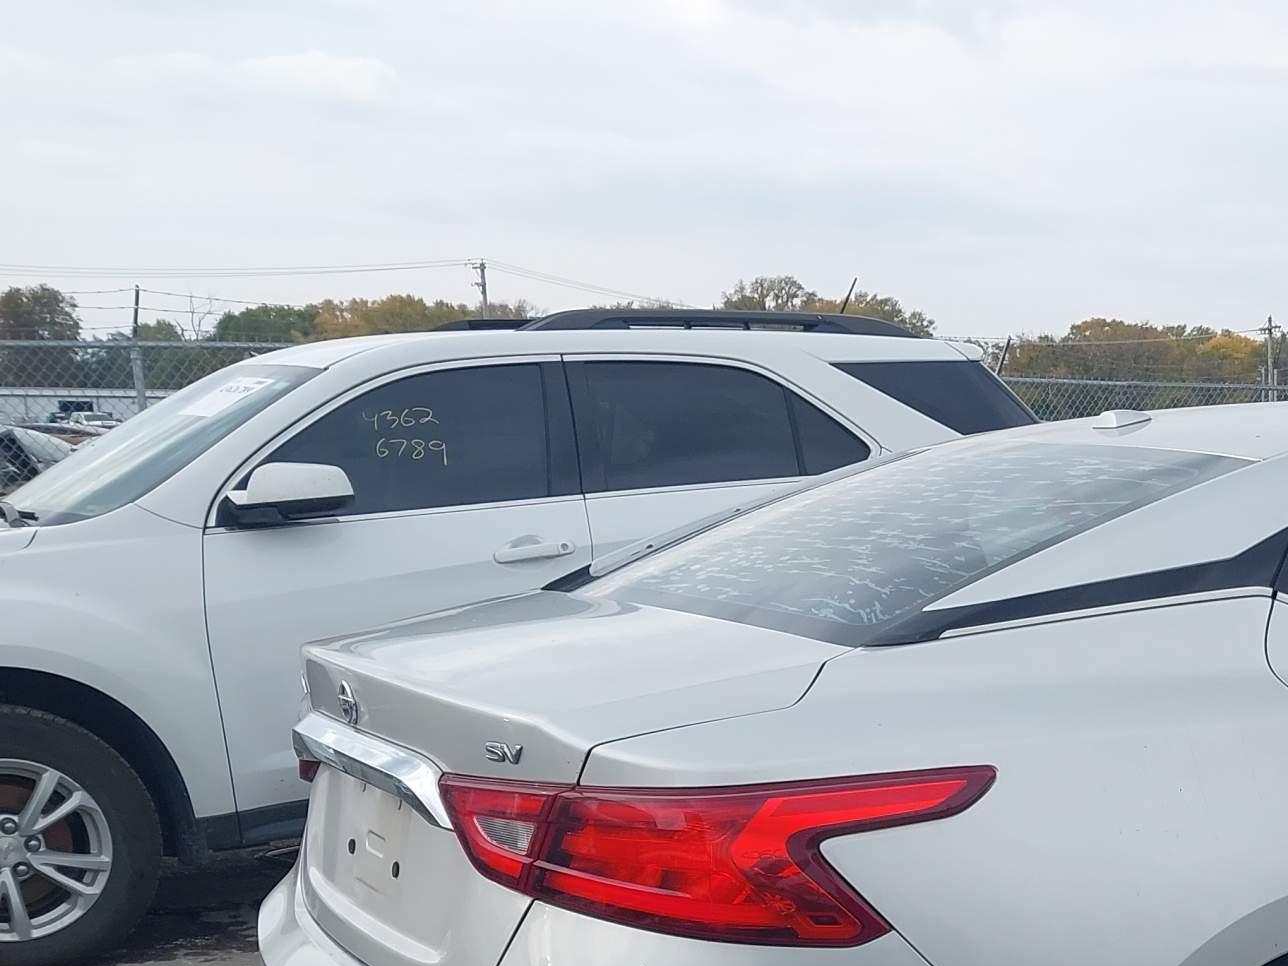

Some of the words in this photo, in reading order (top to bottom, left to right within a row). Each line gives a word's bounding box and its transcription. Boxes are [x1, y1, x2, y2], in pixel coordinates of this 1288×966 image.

[362, 407, 440, 431] 4362
[376, 438, 447, 466] 6789
[485, 740, 524, 765] SV
